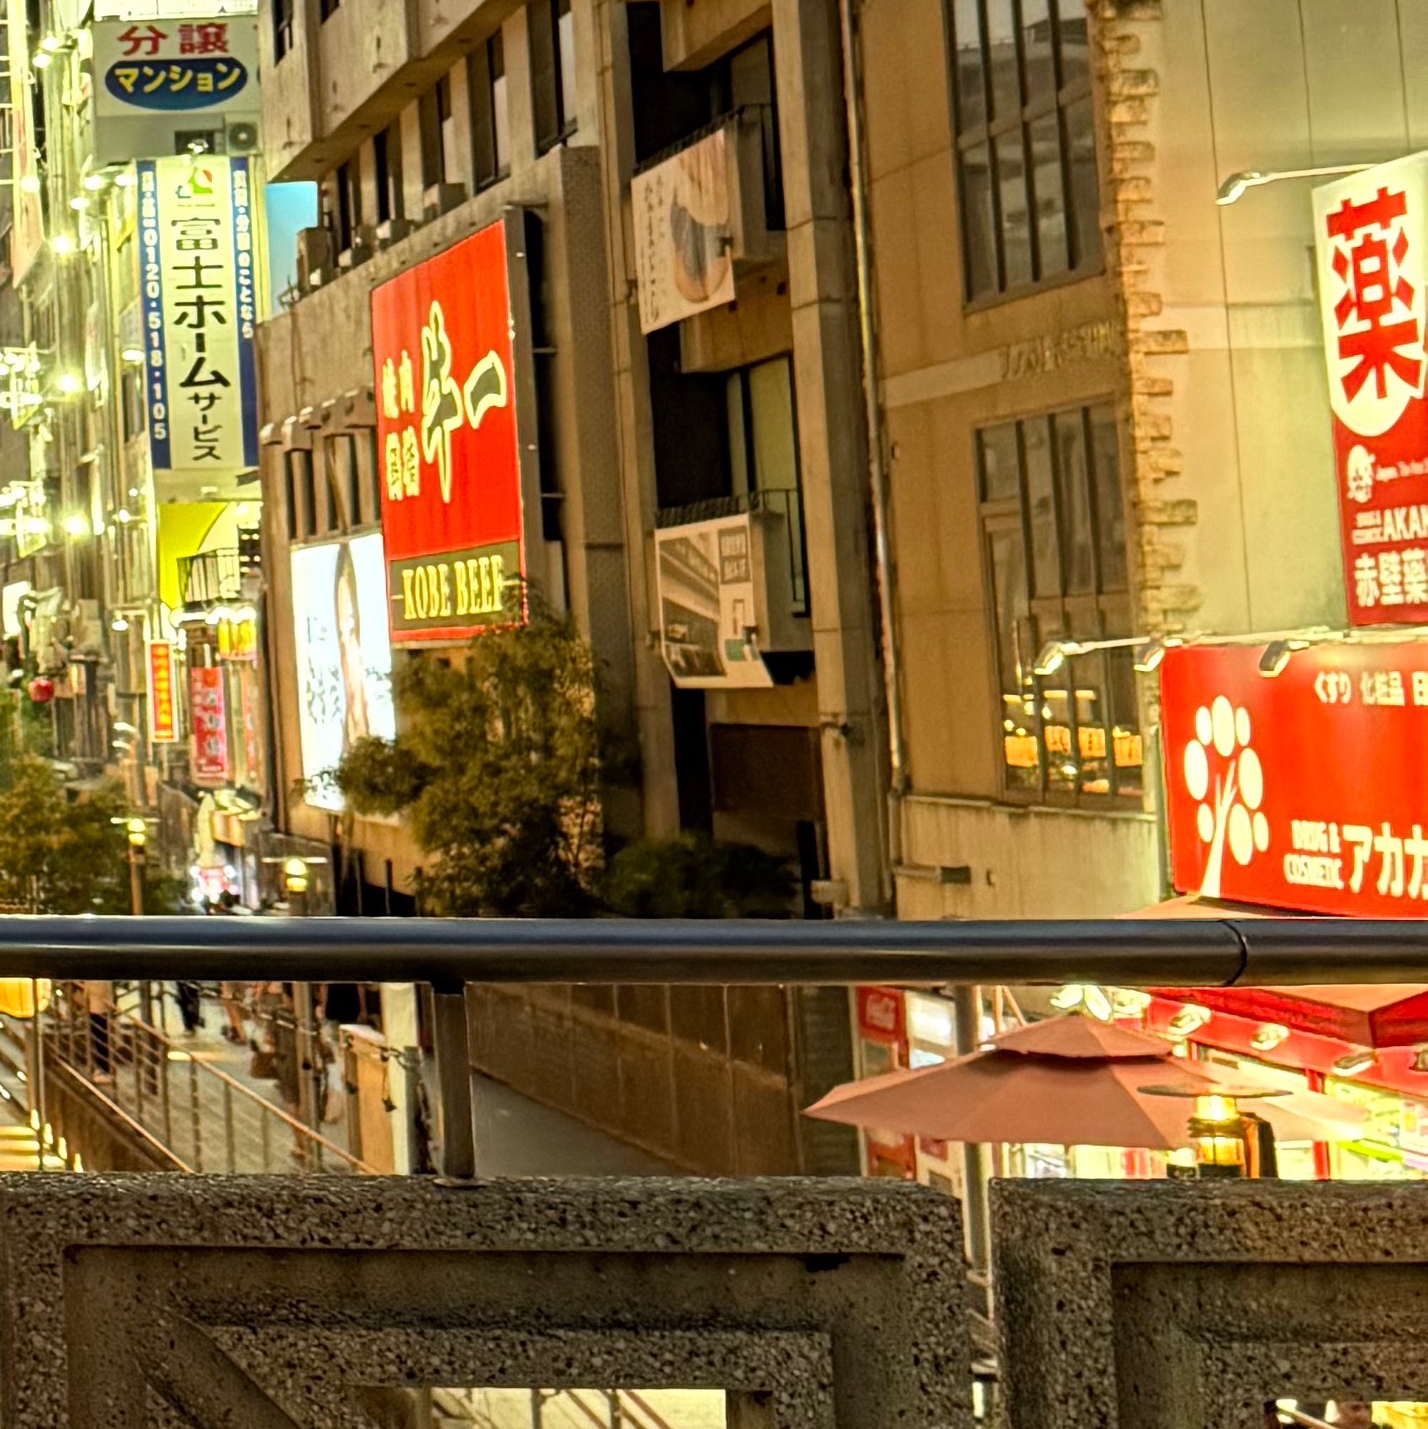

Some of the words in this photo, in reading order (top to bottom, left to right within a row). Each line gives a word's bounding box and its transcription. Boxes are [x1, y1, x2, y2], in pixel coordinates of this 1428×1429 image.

[114, 62, 241, 93] マンション
[1325, 185, 1423, 404] 薬
[171, 216, 232, 461] 富士ホームサービス
[401, 562, 451, 621] KOBE
[453, 554, 504, 616] BEEF
[1314, 670, 1352, 704] くすり
